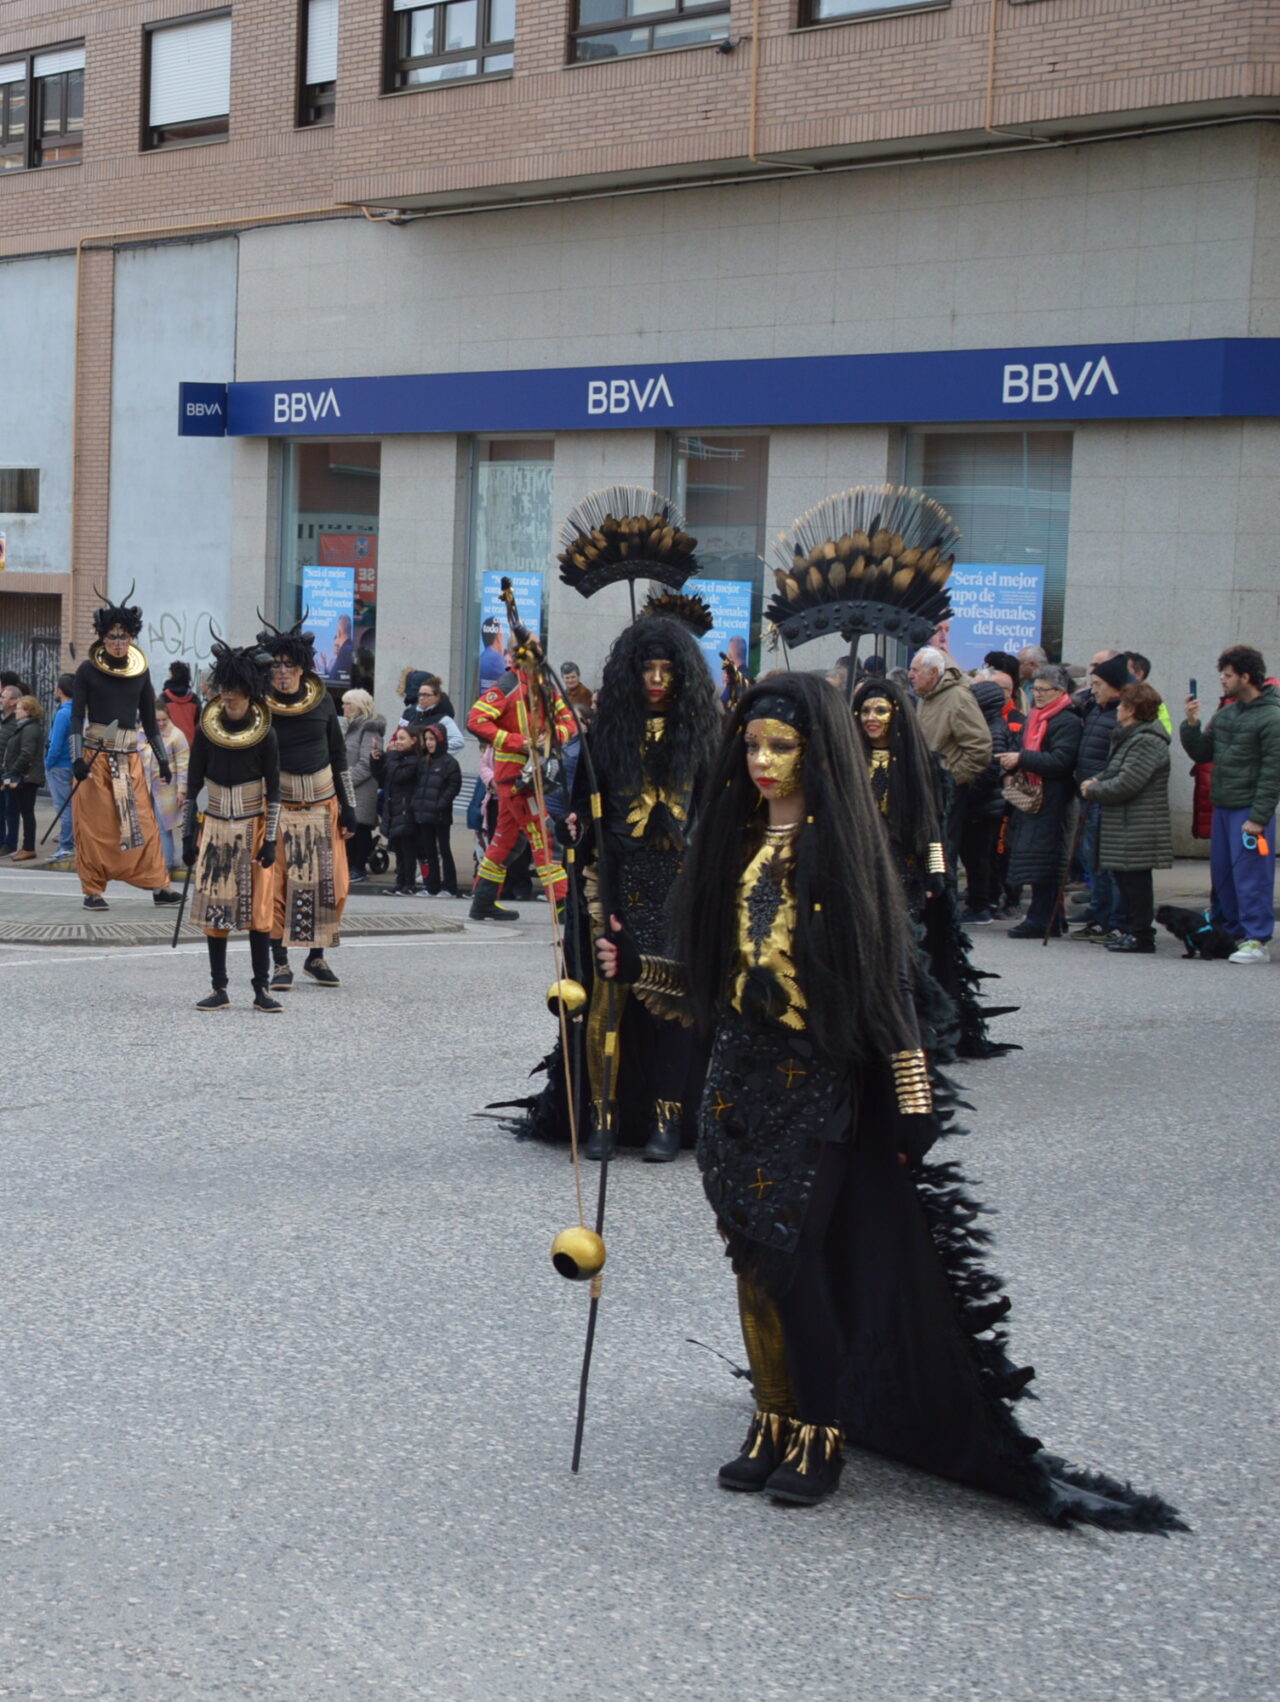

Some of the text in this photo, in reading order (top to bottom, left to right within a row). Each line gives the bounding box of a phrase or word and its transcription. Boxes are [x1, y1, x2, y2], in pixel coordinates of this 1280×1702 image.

[1002, 355, 1119, 403] BBVA
[588, 373, 674, 414] BBVA
[186, 403, 222, 416] BBVA
[274, 387, 341, 423] BBVA
[985, 571, 997, 587] el
[999, 572, 1039, 590] mejor
[979, 587, 996, 603] de
[973, 620, 1036, 638] del sector
[1003, 638, 1021, 654] de
